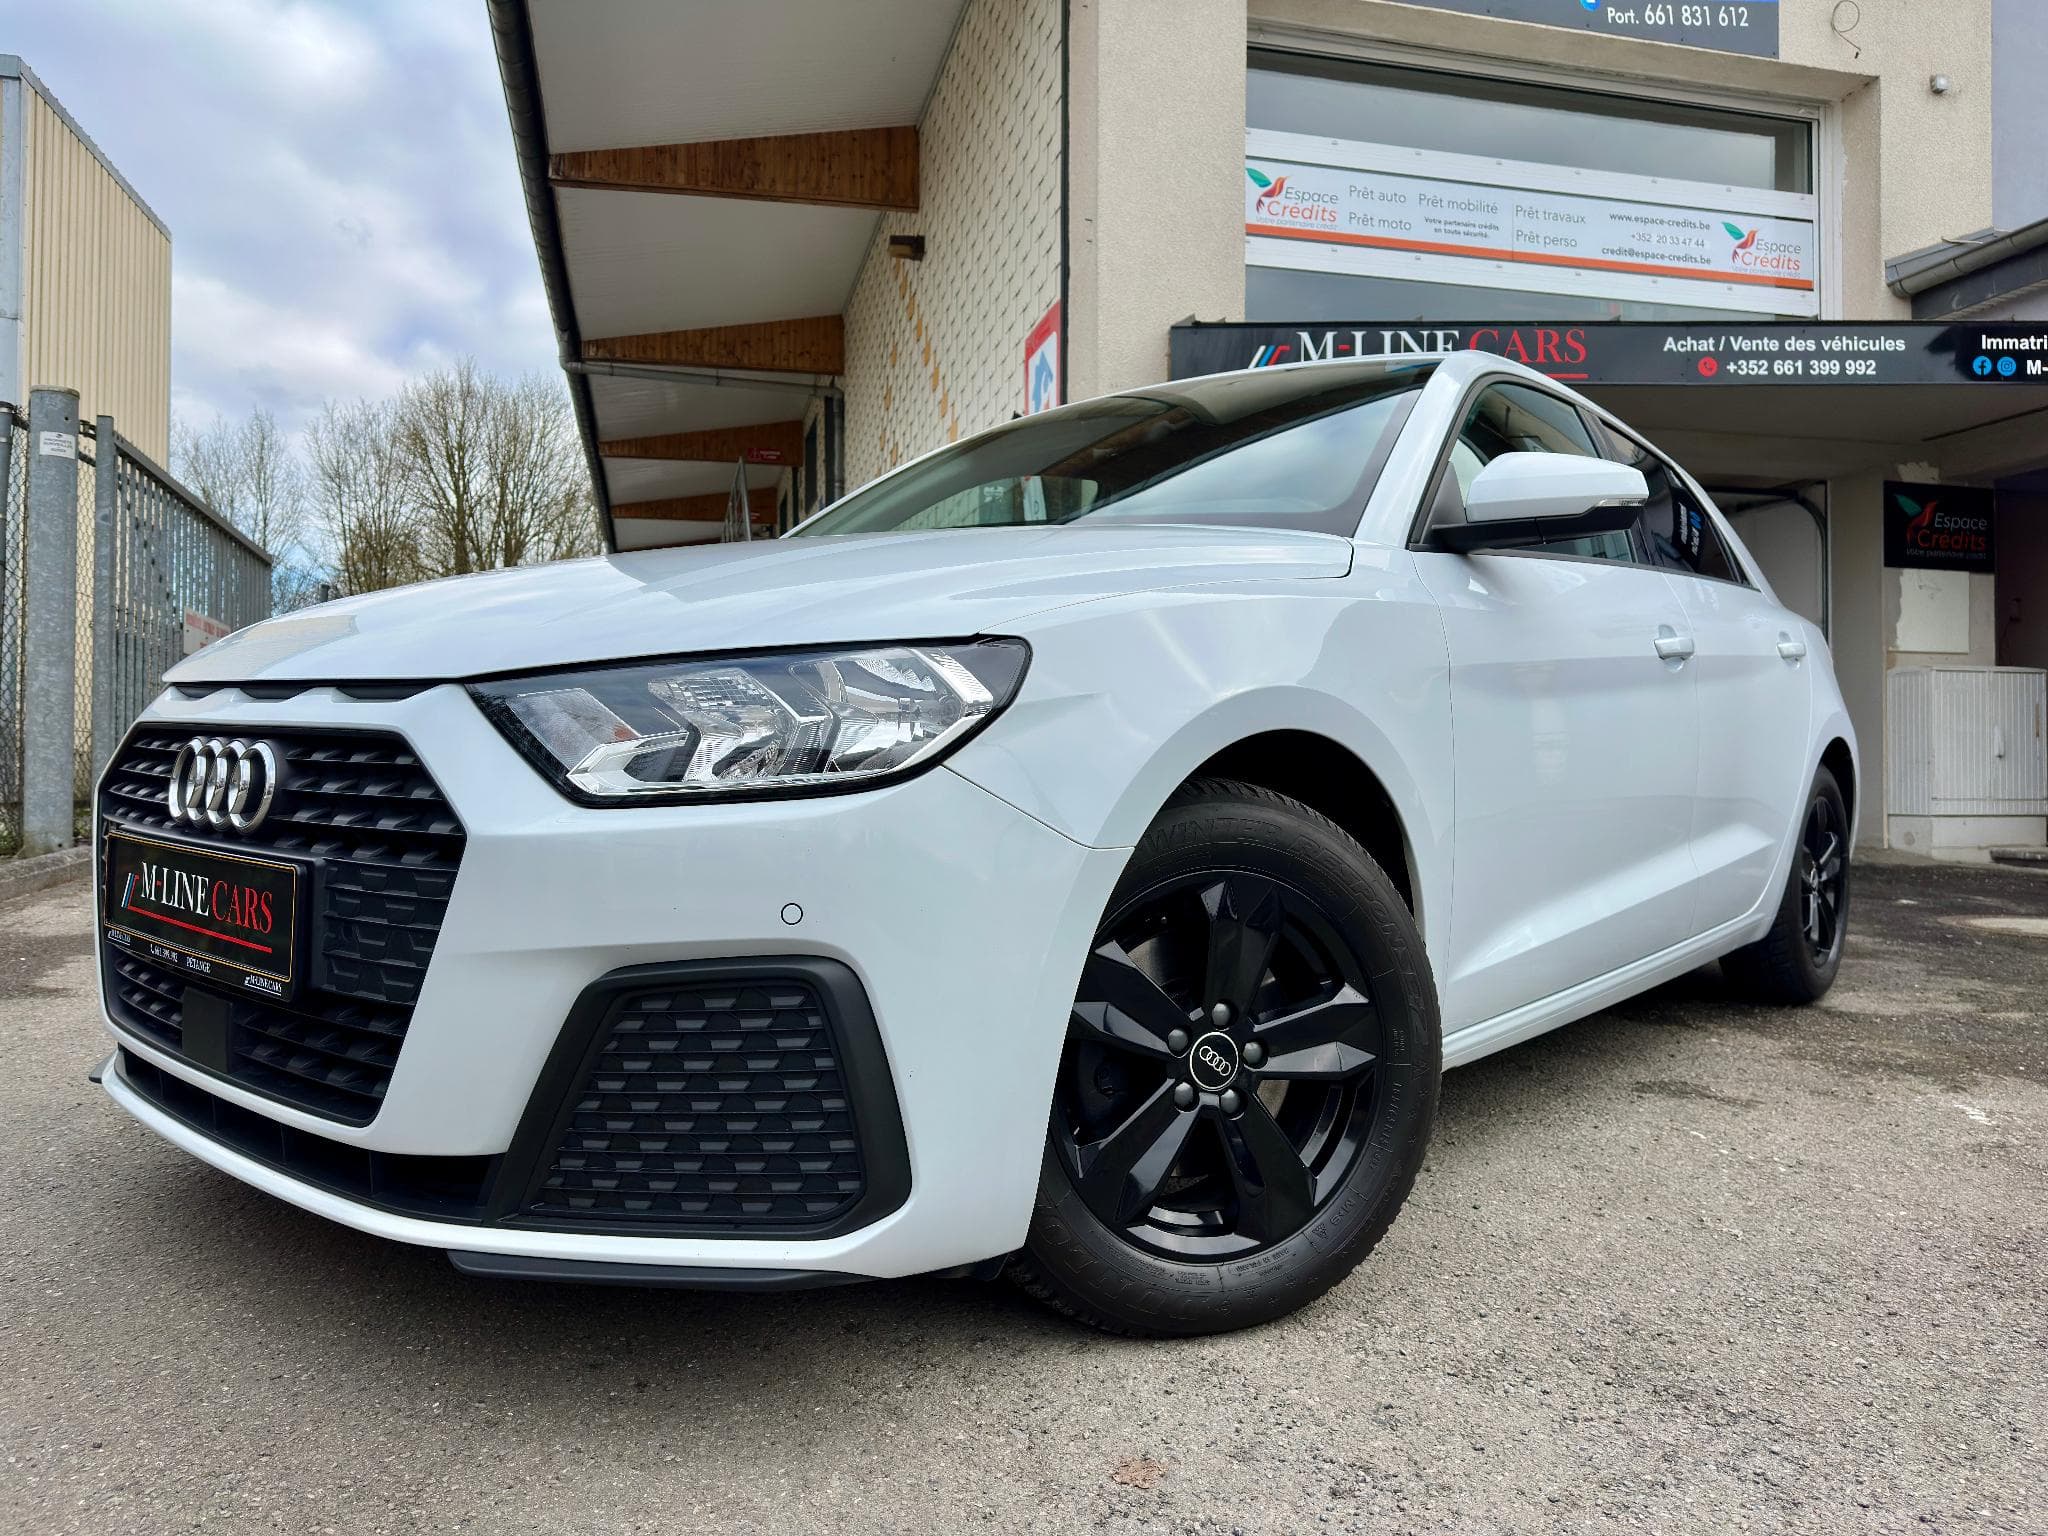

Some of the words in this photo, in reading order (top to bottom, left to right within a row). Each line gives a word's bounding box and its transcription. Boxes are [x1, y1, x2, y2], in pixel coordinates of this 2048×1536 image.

[1607, 7, 1639, 24] Port.
[1644, 3, 1674, 25] 661
[1681, 5, 1711, 26] 831
[1718, 6, 1749, 27] 612
[1284, 186, 1339, 205] Espace
[1349, 184, 1375, 201] Prêt
[1378, 188, 1407, 204] auto
[1267, 200, 1338, 222] Crédits
[1418, 193, 1444, 209] Prêt
[1447, 196, 1499, 215] mobilité
[1349, 212, 1375, 228] Prêt
[1378, 216, 1412, 231] moto
[1515, 204, 1541, 220] Prêt
[1543, 208, 1586, 225] travaux
[1609, 213, 1711, 230] www.espace-credits.be
[1516, 229, 1541, 245] Prêt
[1544, 234, 1577, 250] perso
[1631, 232, 1652, 242] +352
[1656, 234, 1667, 244] 20
[1669, 236, 1680, 245] 33
[1681, 237, 1692, 247] 47
[1694, 239, 1705, 248] 44
[1756, 238, 1801, 255] Espace
[1601, 246, 1711, 265] credit@espace-credits.be
[1741, 249, 1801, 271] Crédits
[1469, 329, 1588, 363] CARS
[1663, 336, 1715, 352] Achat
[1718, 336, 1726, 352] /
[1730, 336, 1780, 352] Vente
[1784, 336, 1816, 352] des
[1820, 336, 1906, 352] véhicules
[1982, 334, 2048, 350] Immatri
[1726, 360, 1769, 376] +352
[1773, 360, 1804, 376] 661
[1809, 360, 1841, 376] 399
[1845, 360, 1877, 376] 992
[1934, 512, 1988, 531] Espace
[1917, 528, 1986, 551] Crédits
[141, 861, 210, 917] M-LINE
[211, 880, 273, 934] CARS
